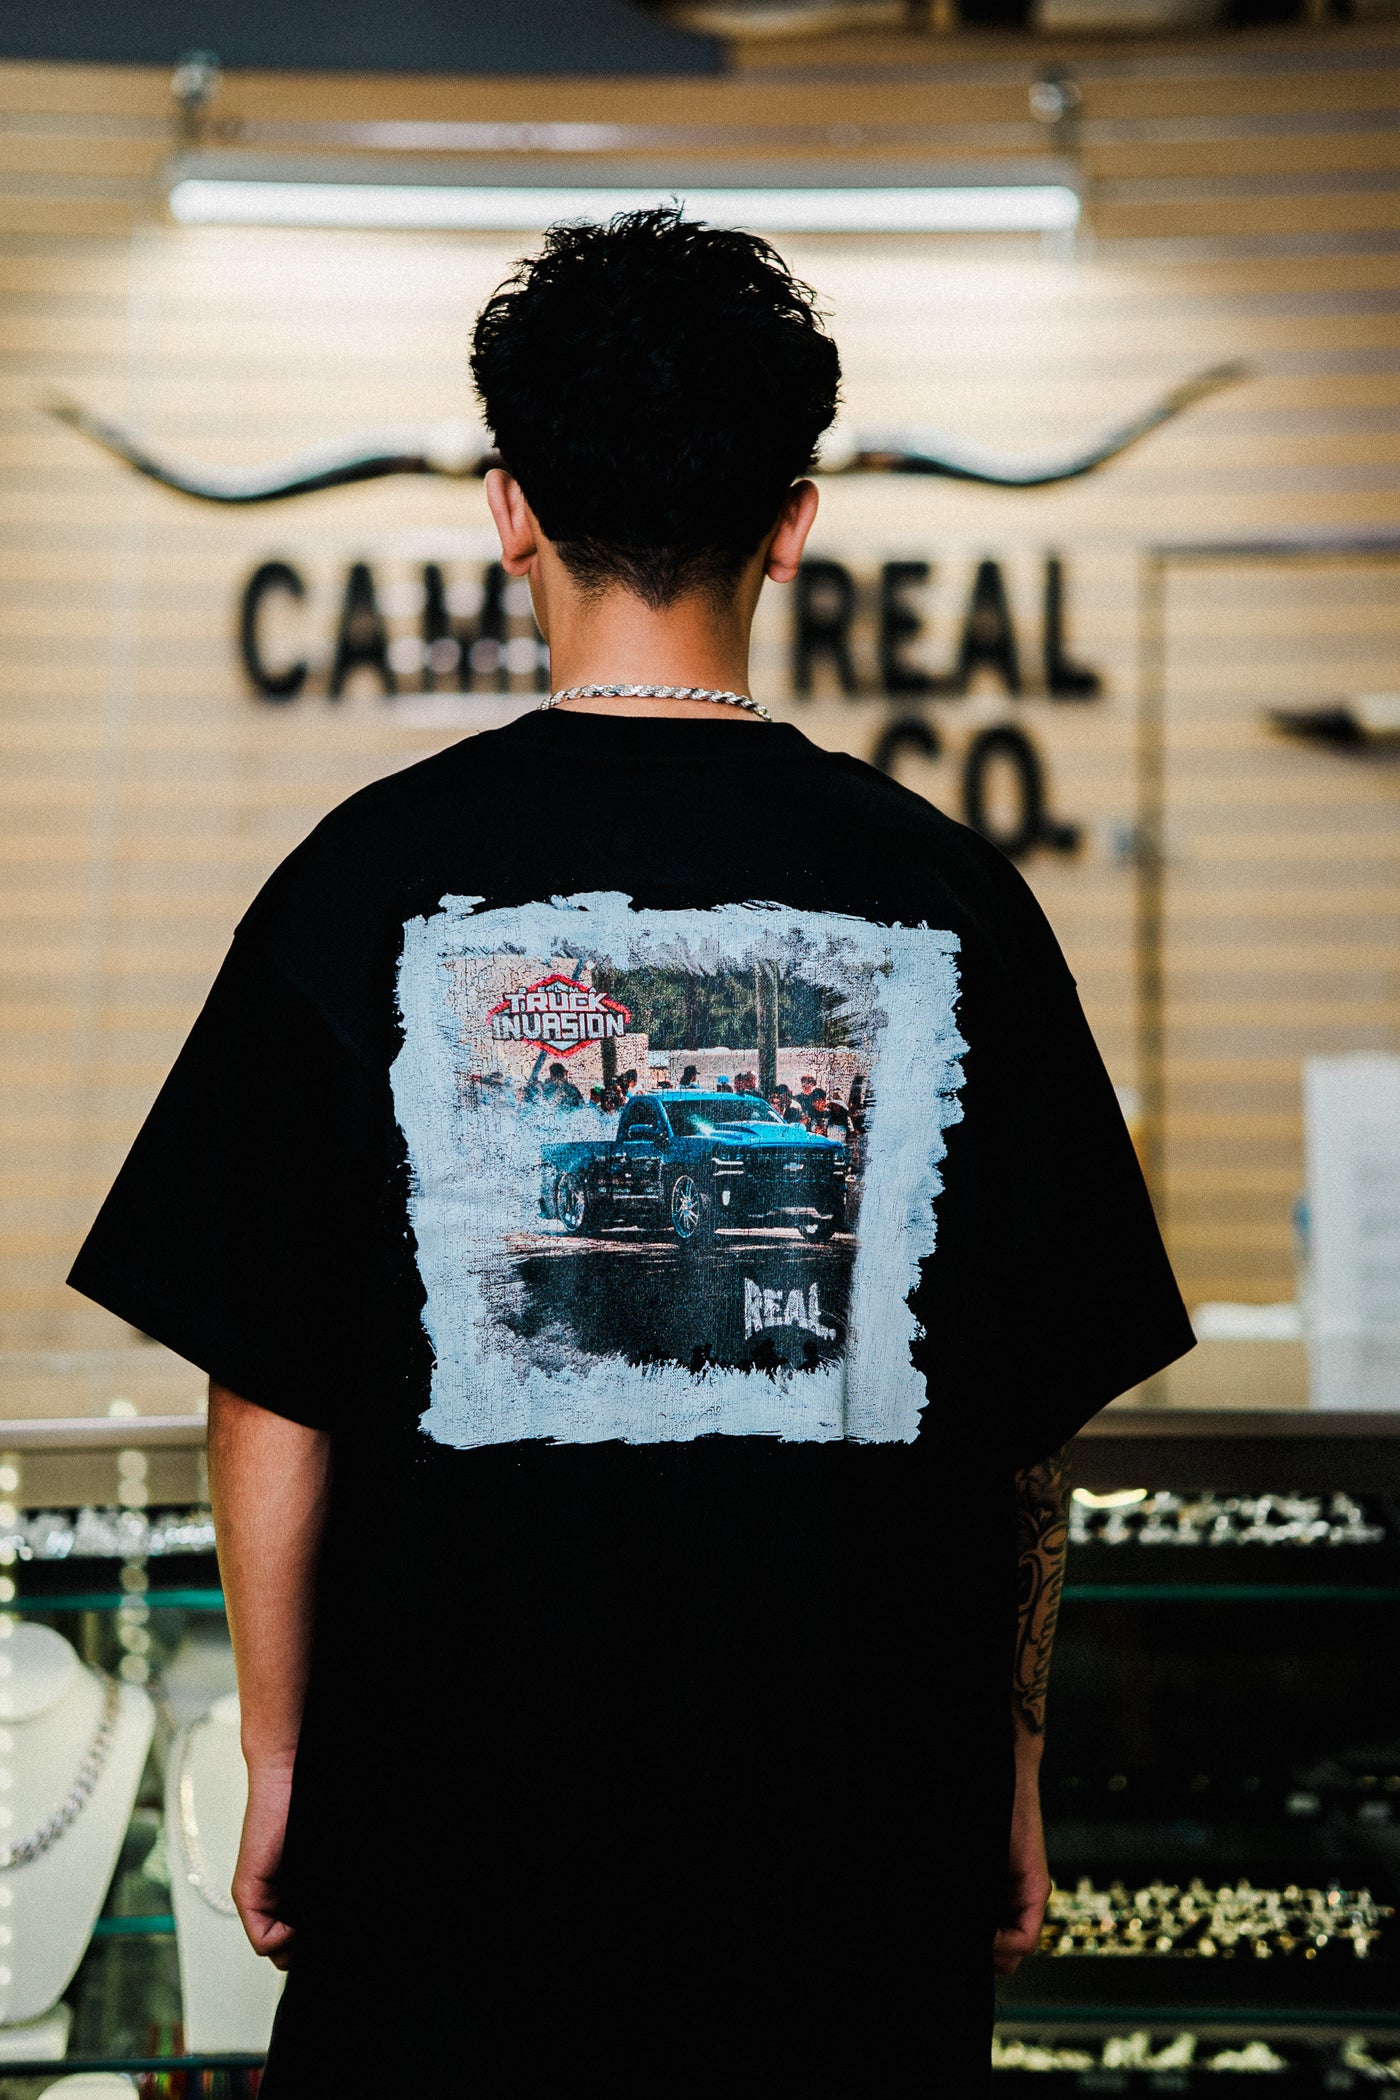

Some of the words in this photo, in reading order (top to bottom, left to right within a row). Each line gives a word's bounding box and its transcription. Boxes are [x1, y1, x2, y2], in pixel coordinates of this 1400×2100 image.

[243, 561, 551, 697] CAM
[795, 559, 1101, 697] REAL
[504, 992, 608, 1012] TRUCK
[492, 1013, 625, 1040] INVASION
